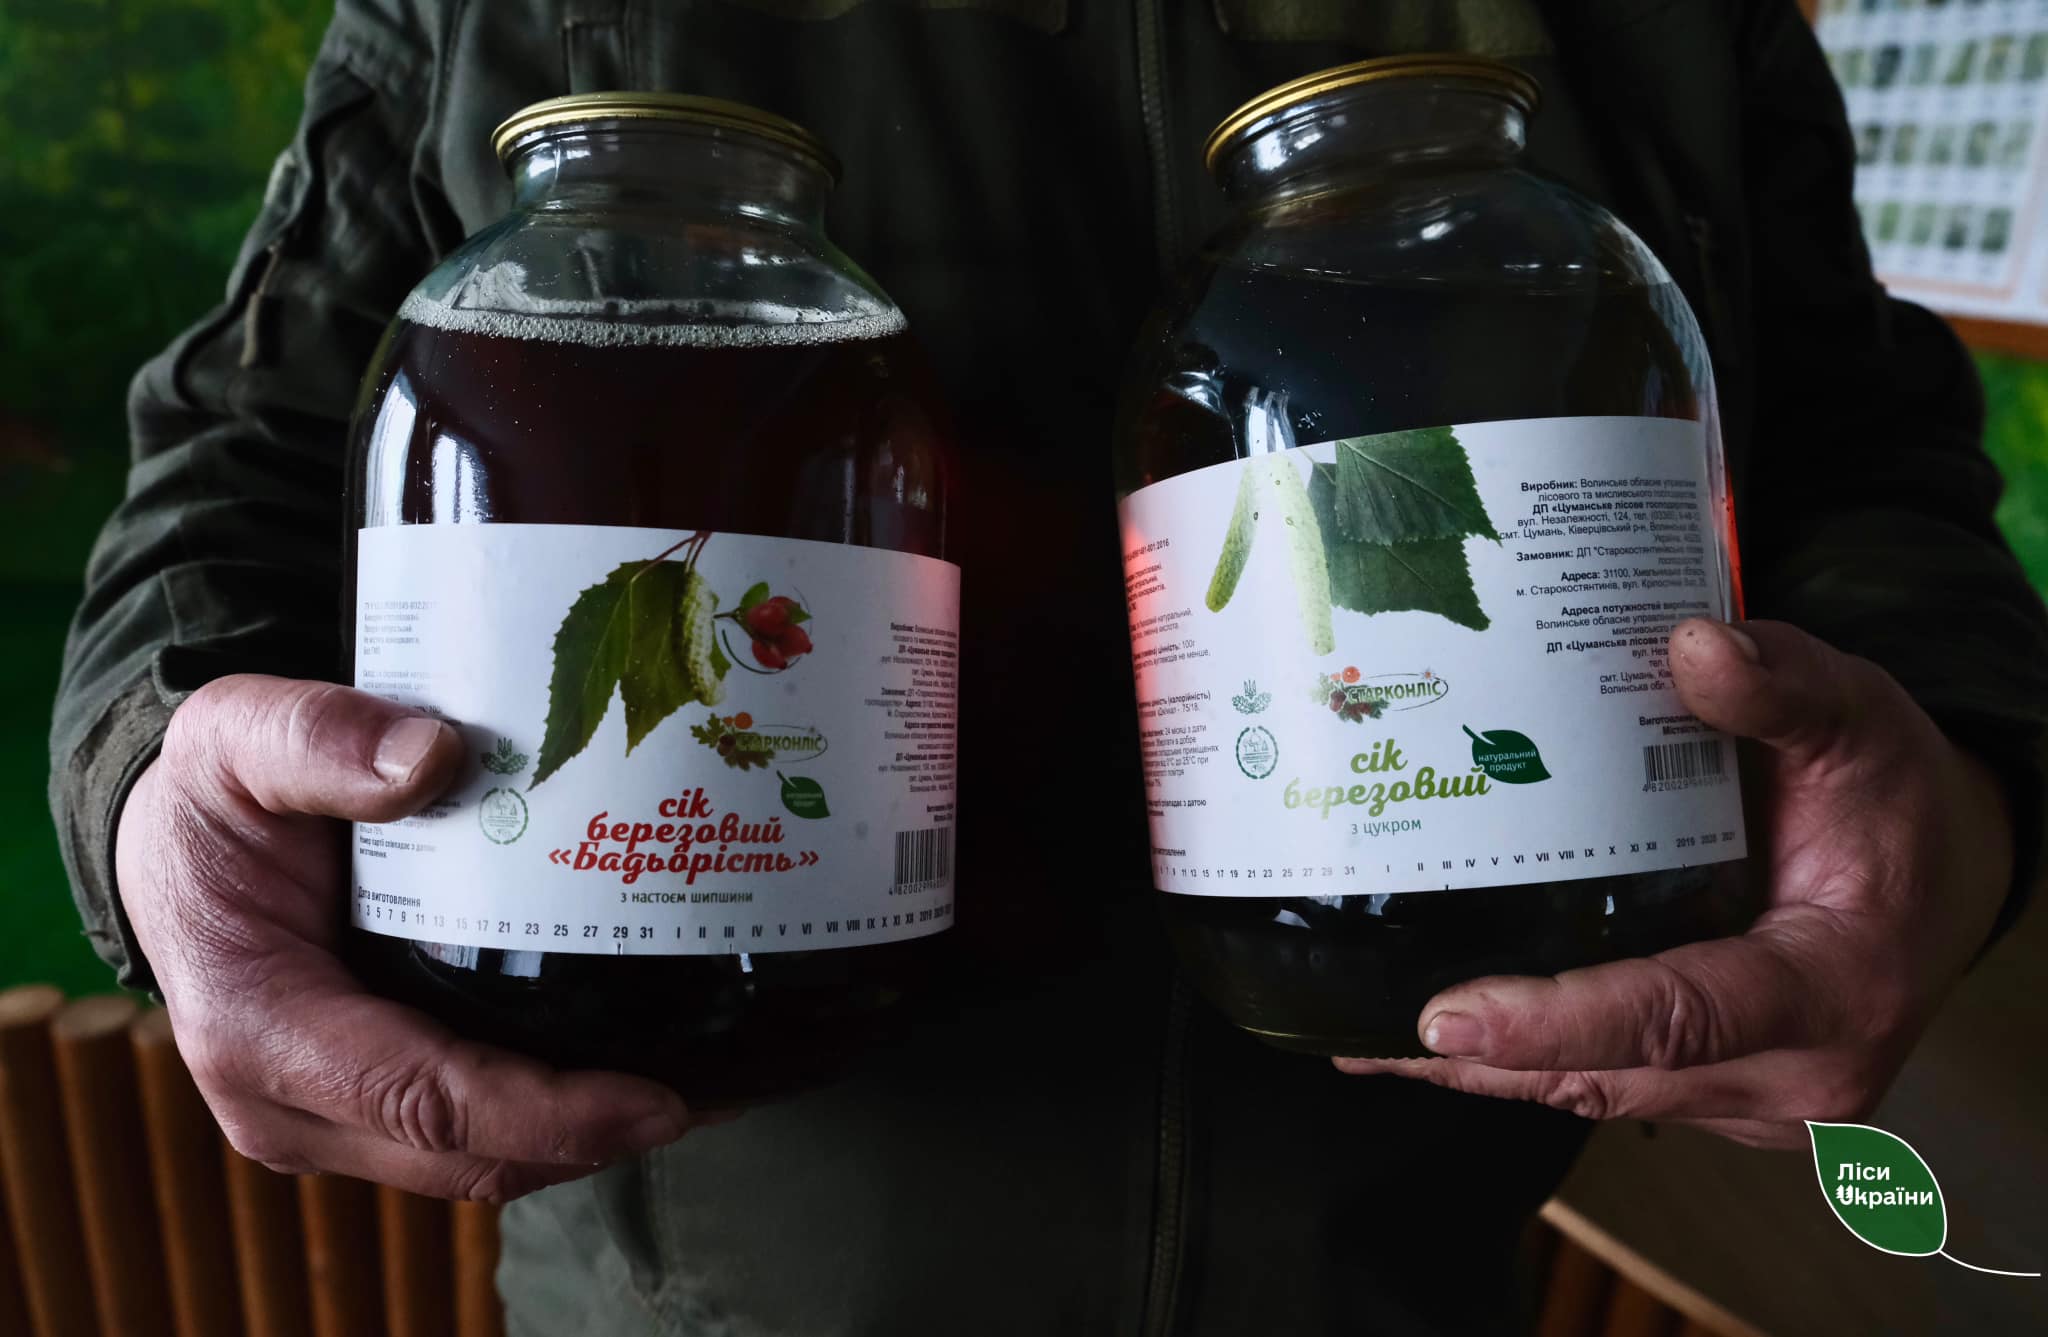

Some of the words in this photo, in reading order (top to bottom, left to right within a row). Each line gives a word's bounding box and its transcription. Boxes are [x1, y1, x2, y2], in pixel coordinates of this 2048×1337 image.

[1520, 480, 1578, 493] Виробник:
[1538, 492, 1580, 502] лісового
[1595, 490, 1652, 499] мисливського
[1532, 503, 1549, 516] ДП
[1517, 518, 1539, 529] вул.
[1541, 514, 1611, 525] Незалежності,
[1613, 511, 1631, 521] 124,
[1500, 531, 1520, 541] смт.
[1523, 527, 1566, 540] Цумань,
[1568, 522, 1632, 536] Ківерцівський
[1516, 550, 1574, 562] Замовник:
[1576, 547, 1591, 559] ДП
[1561, 571, 1601, 583] Адреса:
[1602, 567, 1630, 579] 31100,
[1516, 588, 1528, 597] м.
[1530, 582, 1620, 596] Старокостянтинів,
[1622, 581, 1640, 591] вул.
[1561, 606, 1600, 617] Адреса
[1536, 618, 1590, 630] Волинське
[1592, 615, 1631, 626] обласне
[1546, 641, 1563, 654] ДП
[1599, 674, 1619, 683] смт.
[1600, 683, 1649, 695] Волинська
[1350, 738, 1408, 774] сік
[1478, 748, 1537, 764] натуральний
[1489, 762, 1527, 773] продукт
[1283, 765, 1492, 820] березовий
[658, 787, 714, 818] сік
[1187, 800, 1207, 808] датою
[586, 810, 785, 853] березовий
[1351, 824, 1358, 835] з
[1363, 817, 1422, 837] цукром
[1181, 868, 1187, 877] 11
[1190, 868, 1197, 878] 13
[1202, 869, 1210, 878] 15
[1216, 869, 1224, 878] 17
[1229, 869, 1239, 878] 19
[1247, 869, 1256, 878] 21
[1263, 868, 1273, 878] 23
[1281, 868, 1293, 878] 25
[1302, 867, 1314, 877] 27
[1344, 865, 1355, 876] 31
[1417, 862, 1424, 872] II
[1442, 860, 1452, 870] III
[1465, 858, 1476, 868] IV
[1491, 856, 1499, 866] V
[1513, 854, 1524, 864] VI
[1535, 852, 1550, 862] VII
[1558, 850, 1575, 860] VIII
[1584, 848, 1595, 858] IX
[1608, 845, 1616, 856] X
[1630, 843, 1640, 853] XI
[1646, 841, 1657, 852] XII
[371, 892, 421, 907] виготовлення
[620, 893, 627, 903] з
[631, 893, 686, 904] настоєм
[690, 892, 753, 903] шипшини
[366, 905, 370, 916] 3
[376, 907, 381, 918] 5
[388, 909, 393, 920] 7
[401, 911, 406, 922] 9
[415, 913, 425, 925] 11
[434, 915, 445, 928] 13
[456, 917, 468, 930] 15
[477, 920, 488, 932] 17
[498, 921, 511, 933] 21
[525, 923, 539, 935] 23
[553, 925, 569, 937] 25
[583, 926, 598, 938] 27
[613, 927, 629, 939] 29
[640, 927, 654, 939] 31
[699, 927, 706, 939] II
[724, 926, 735, 938] III
[751, 925, 763, 937] IV
[779, 924, 787, 936] V
[801, 923, 812, 935] VI
[826, 922, 839, 934] VII
[846, 919, 860, 932] VIII
[867, 917, 876, 930] IX
[882, 916, 888, 928] X
